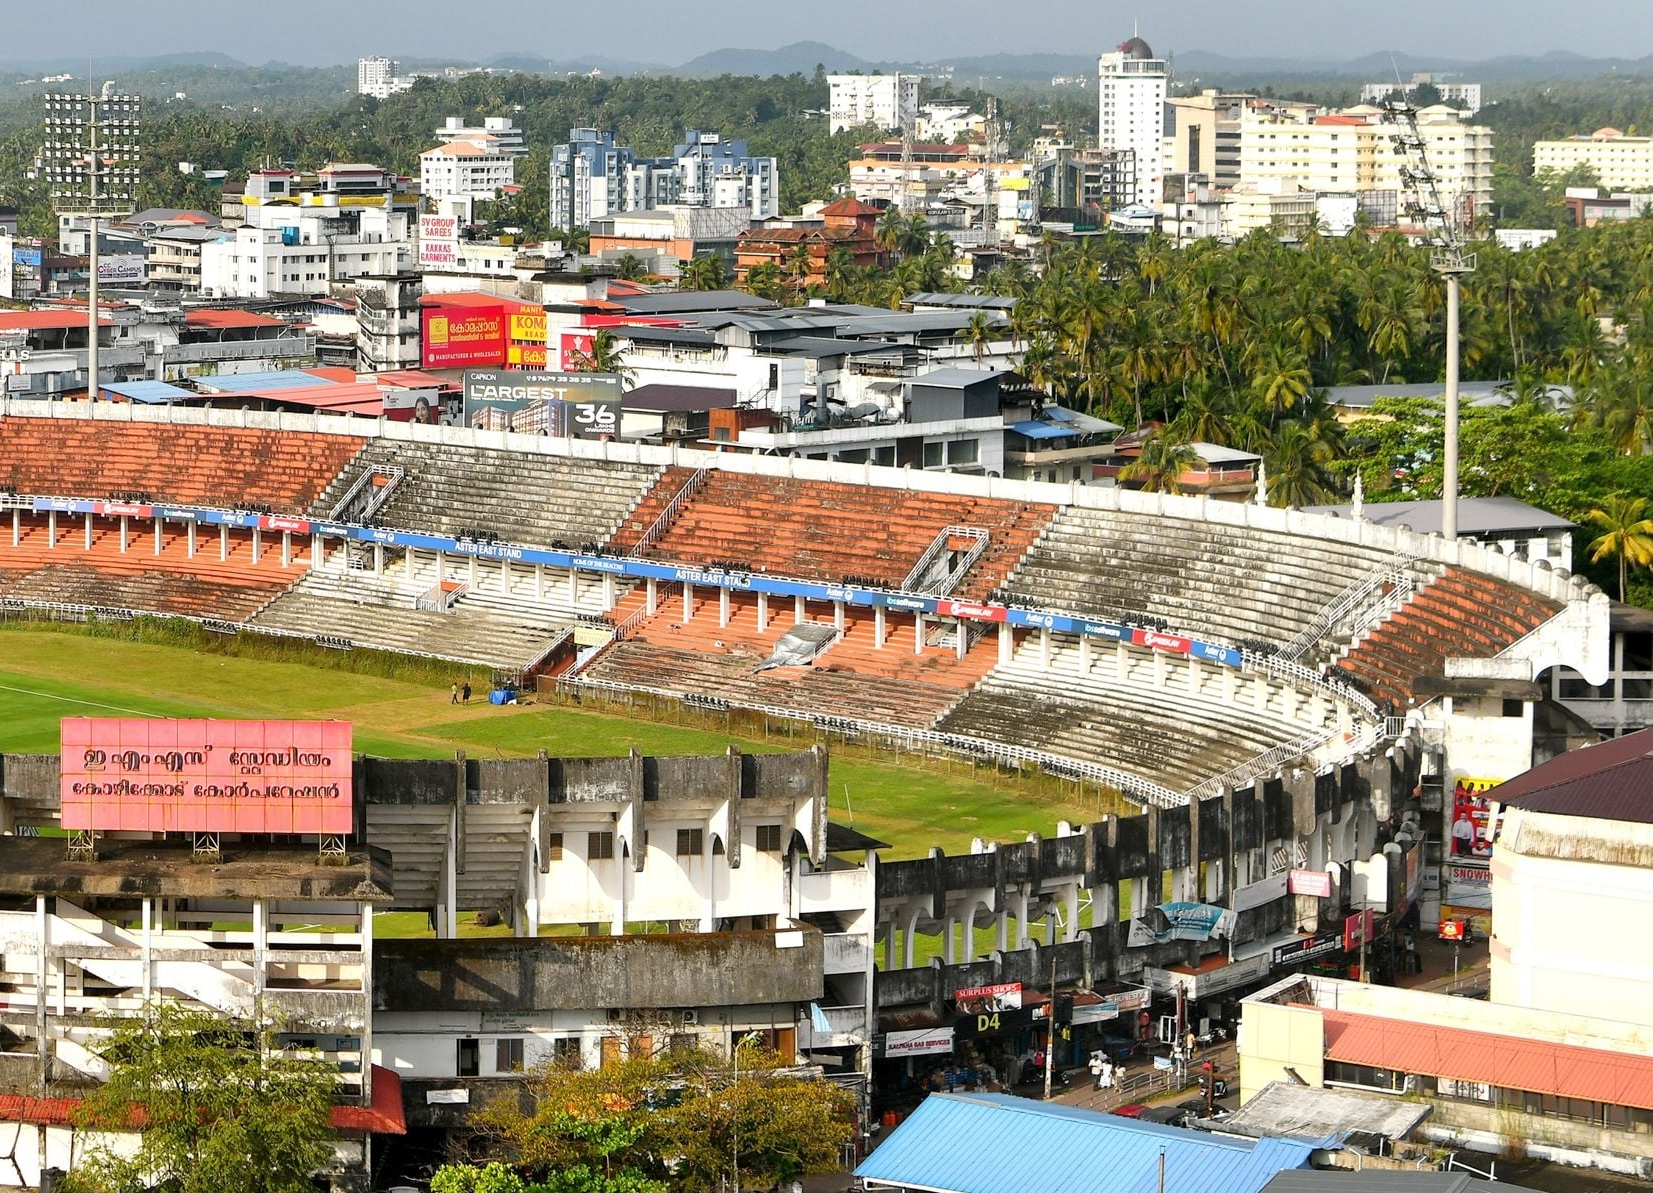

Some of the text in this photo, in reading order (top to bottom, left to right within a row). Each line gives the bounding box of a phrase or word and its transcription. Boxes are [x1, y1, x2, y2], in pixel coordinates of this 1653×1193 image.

[431, 218, 455, 227] GROUP
[425, 228, 452, 237] SAREES
[425, 243, 452, 253] KAKKAS
[421, 253, 456, 263] GARMENTS
[524, 331, 546, 339] READ
[470, 384, 568, 400] LARGEST
[575, 404, 616, 424] 36
[454, 541, 522, 559] ASTER EAST STAND
[675, 569, 701, 582] ASTER
[702, 572, 724, 584] EAST
[84, 750, 106, 771] ഇ
[959, 987, 992, 998] SURPLUS
[977, 1013, 1001, 1032] D4
